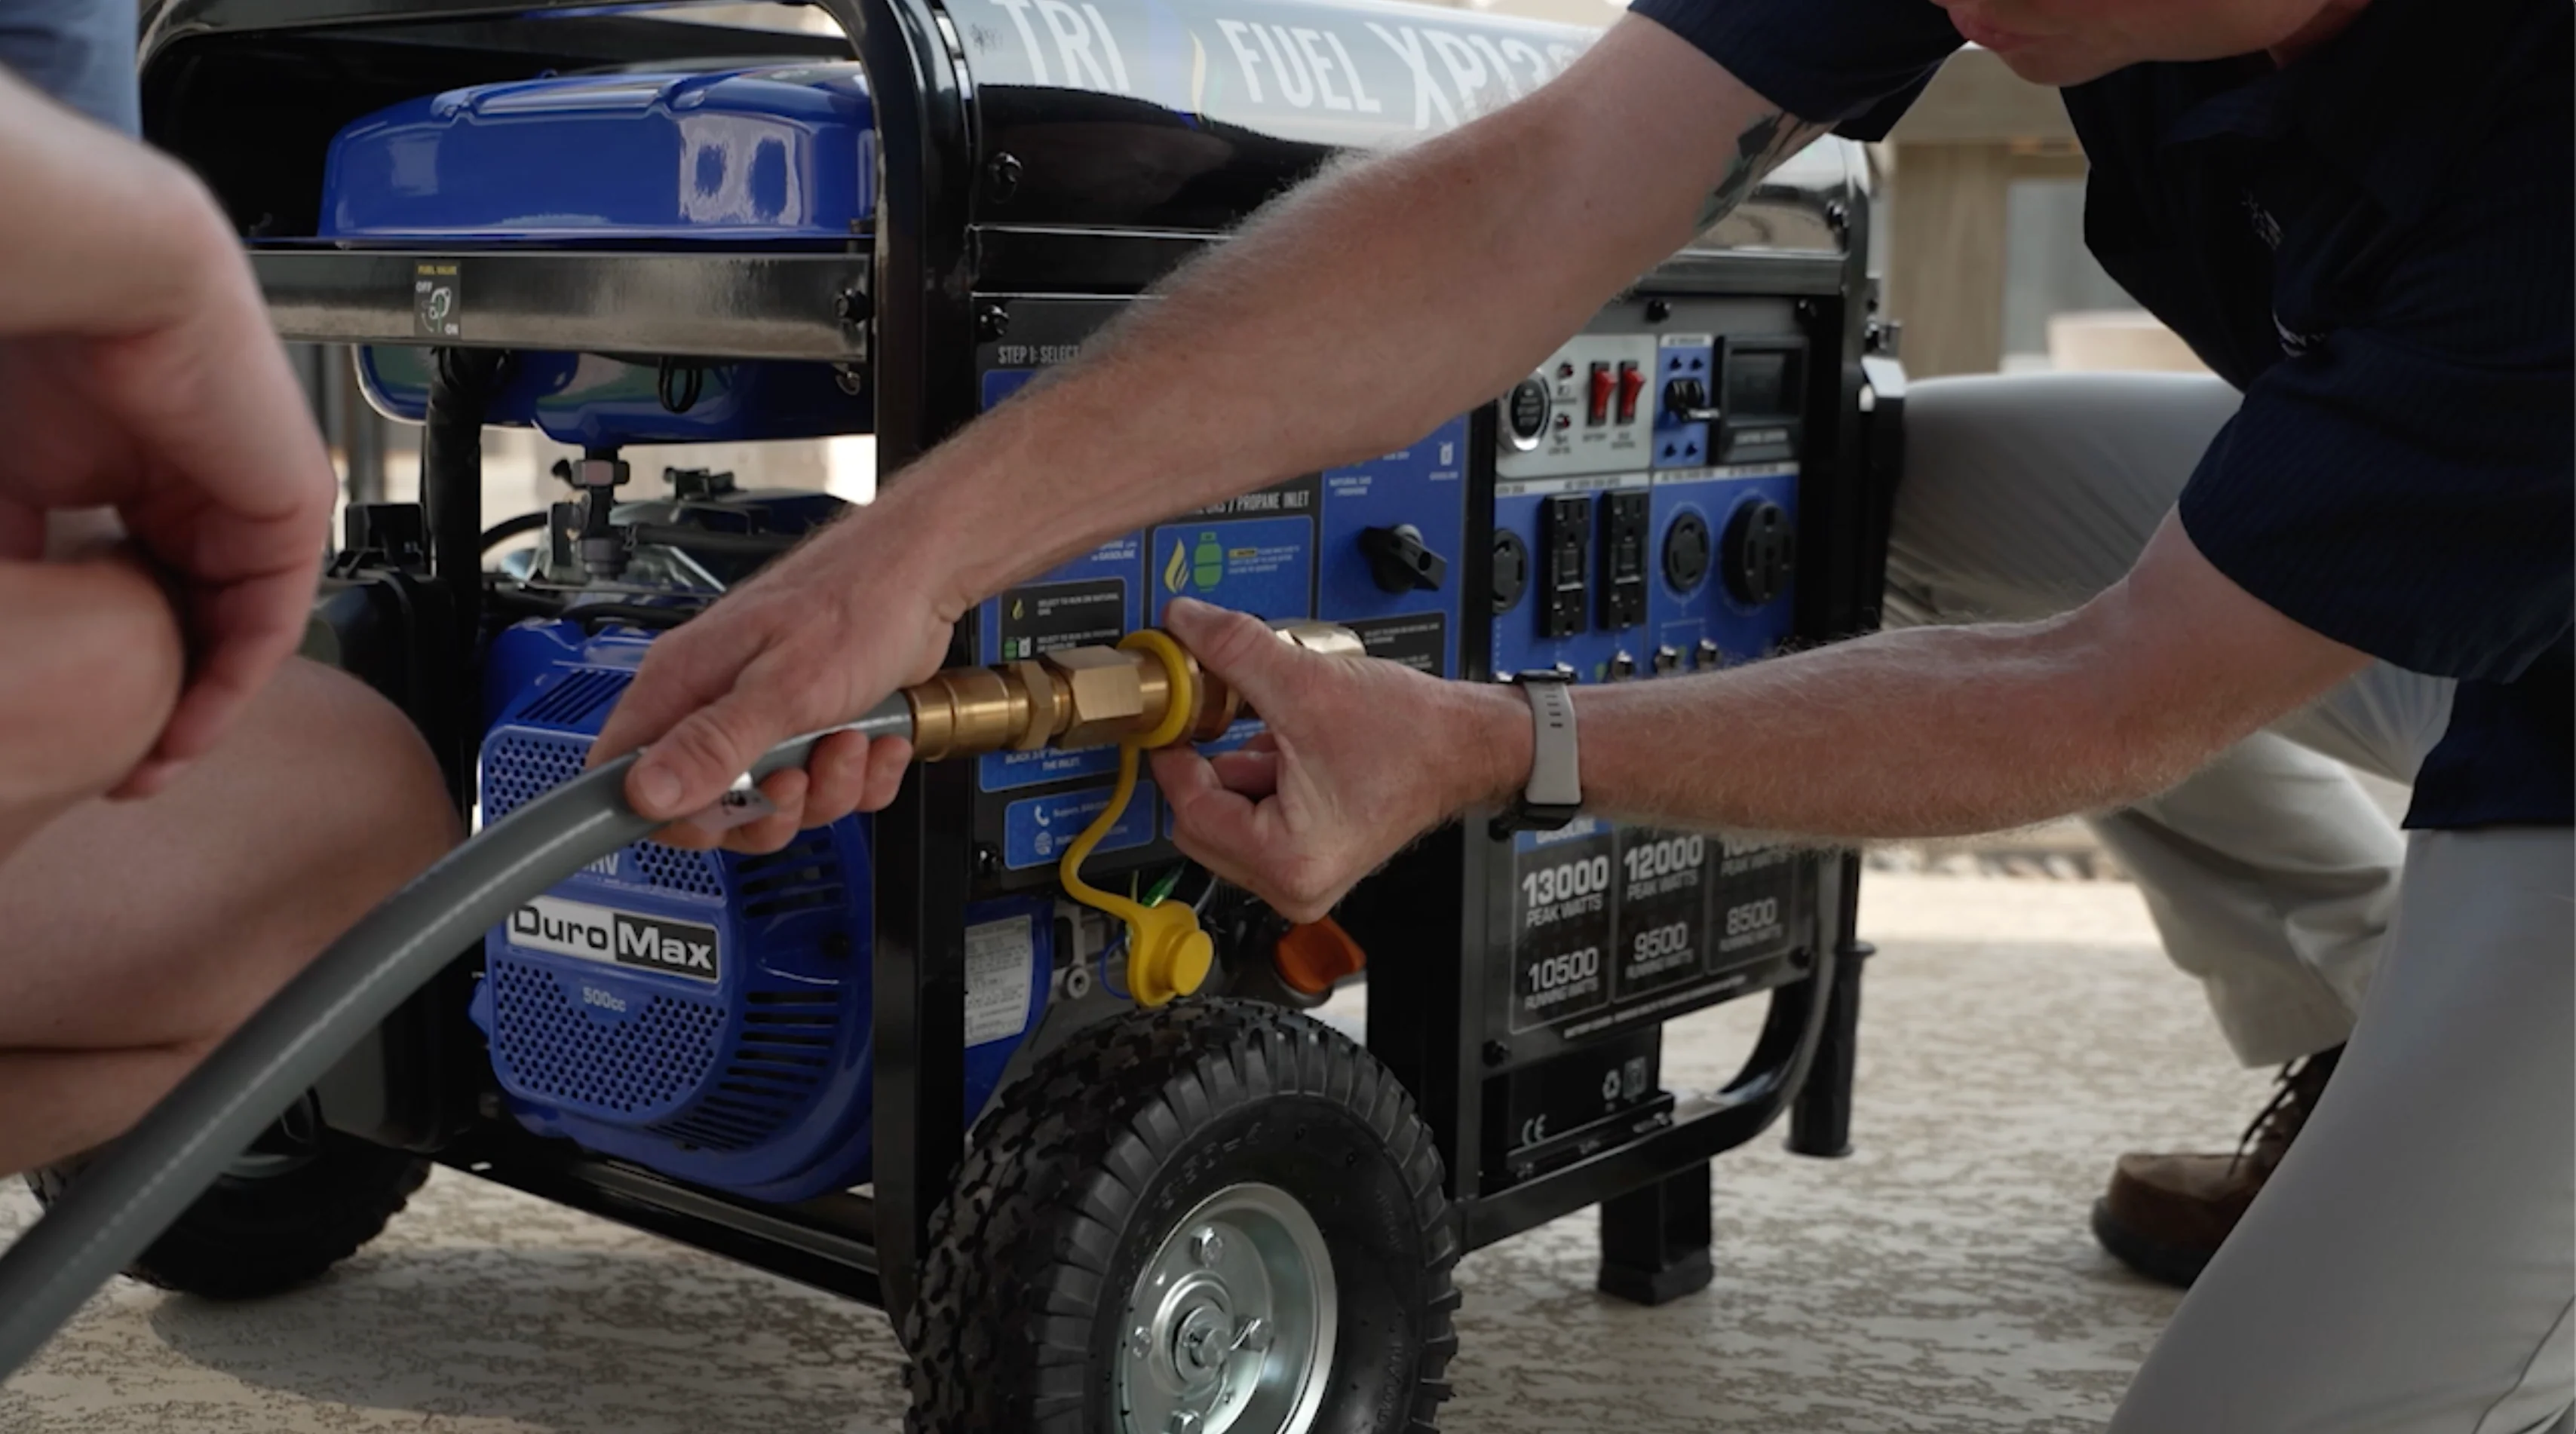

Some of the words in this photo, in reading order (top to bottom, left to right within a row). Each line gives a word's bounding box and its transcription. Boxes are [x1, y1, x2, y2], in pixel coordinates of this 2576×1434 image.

[1006, 0, 1131, 91] TRI
[1216, 19, 1382, 113] FUEL
[416, 280, 433, 293] OFF
[445, 323, 459, 336] ON
[998, 345, 1027, 364] STEP
[1039, 345, 1080, 363] SELECT
[1236, 492, 1281, 513] PROPANE
[1283, 490, 1310, 510] INLET
[1624, 835, 1704, 882] 12000
[1522, 855, 1609, 907] 13000
[1627, 879, 1658, 902] PEAK
[1660, 869, 1699, 893] WATTS
[1526, 903, 1559, 928] PEAK
[1560, 892, 1604, 919] WATTS
[1726, 896, 1778, 936] 8500
[1633, 921, 1688, 961] 9500
[1528, 947, 1599, 993] 10500
[582, 987, 626, 1013] 500cc
[1525, 985, 1568, 1011] RUNNING
